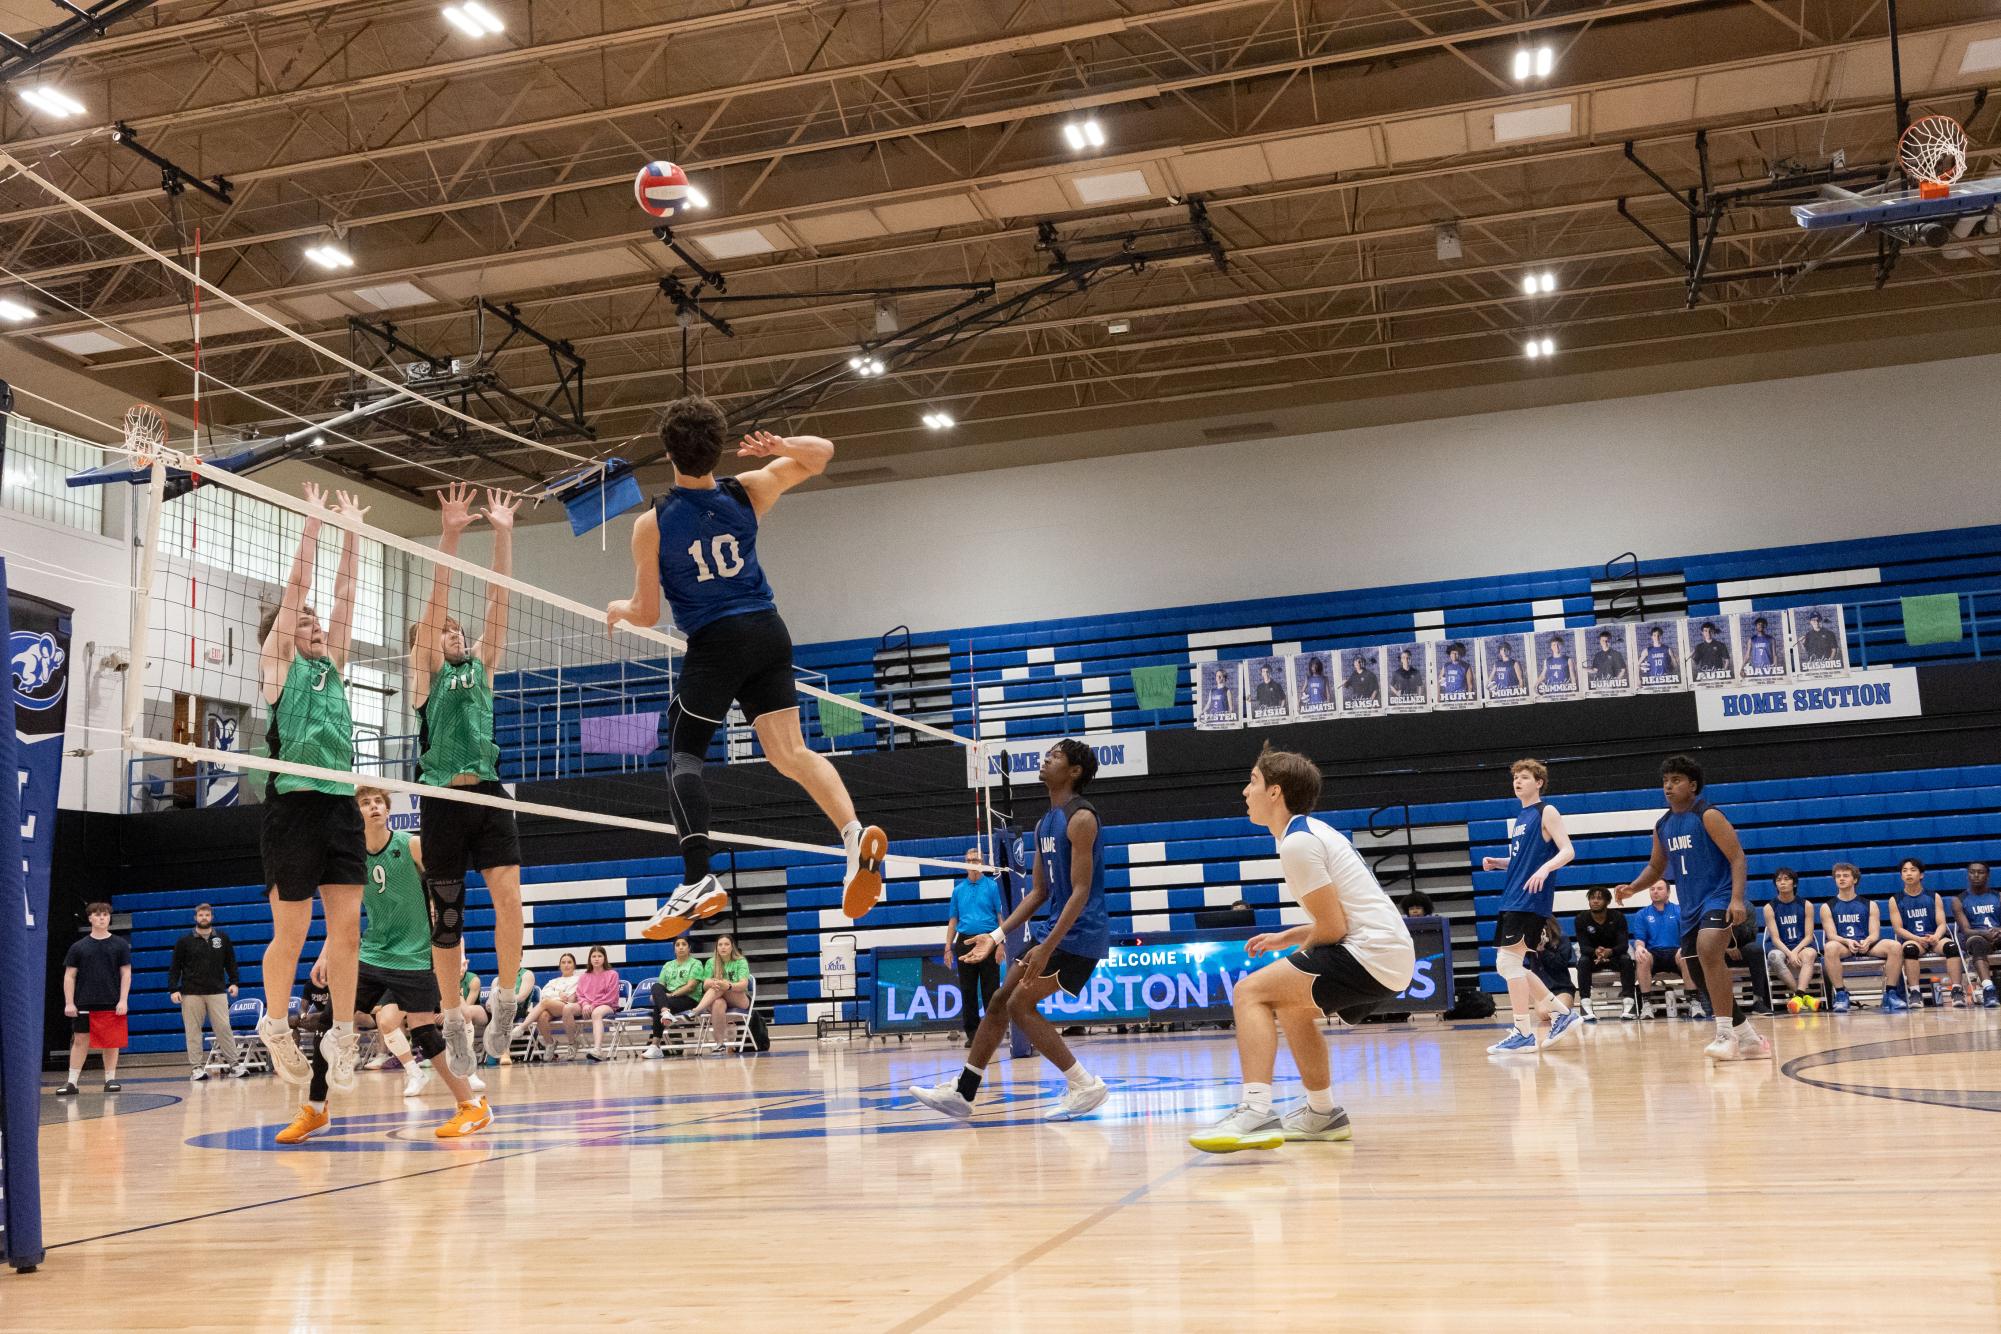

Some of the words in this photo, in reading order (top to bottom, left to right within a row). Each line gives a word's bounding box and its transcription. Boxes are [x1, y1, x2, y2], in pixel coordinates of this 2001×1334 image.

[688, 534, 745, 582] 10
[1802, 659, 1842, 671] SCISSORS
[1696, 670, 1732, 681] AUDI
[1744, 666, 1785, 676] DAVIS
[1642, 674, 1680, 685] REISER
[1491, 687, 1527, 697] MORAN
[1538, 683, 1577, 692] SUMMERS
[1440, 692, 1476, 701] HURT
[1722, 691, 1788, 717] HOME
[1792, 683, 1891, 711] SECTION
[373, 865, 386, 893] 9
[1837, 913, 1860, 924] LADUE
[1907, 907, 1928, 919] LADUE
[1846, 926, 1855, 937] 3
[1915, 920, 1924, 932] 5
[1787, 927, 1797, 939] 11
[235, 1003, 256, 1011] LADUE
